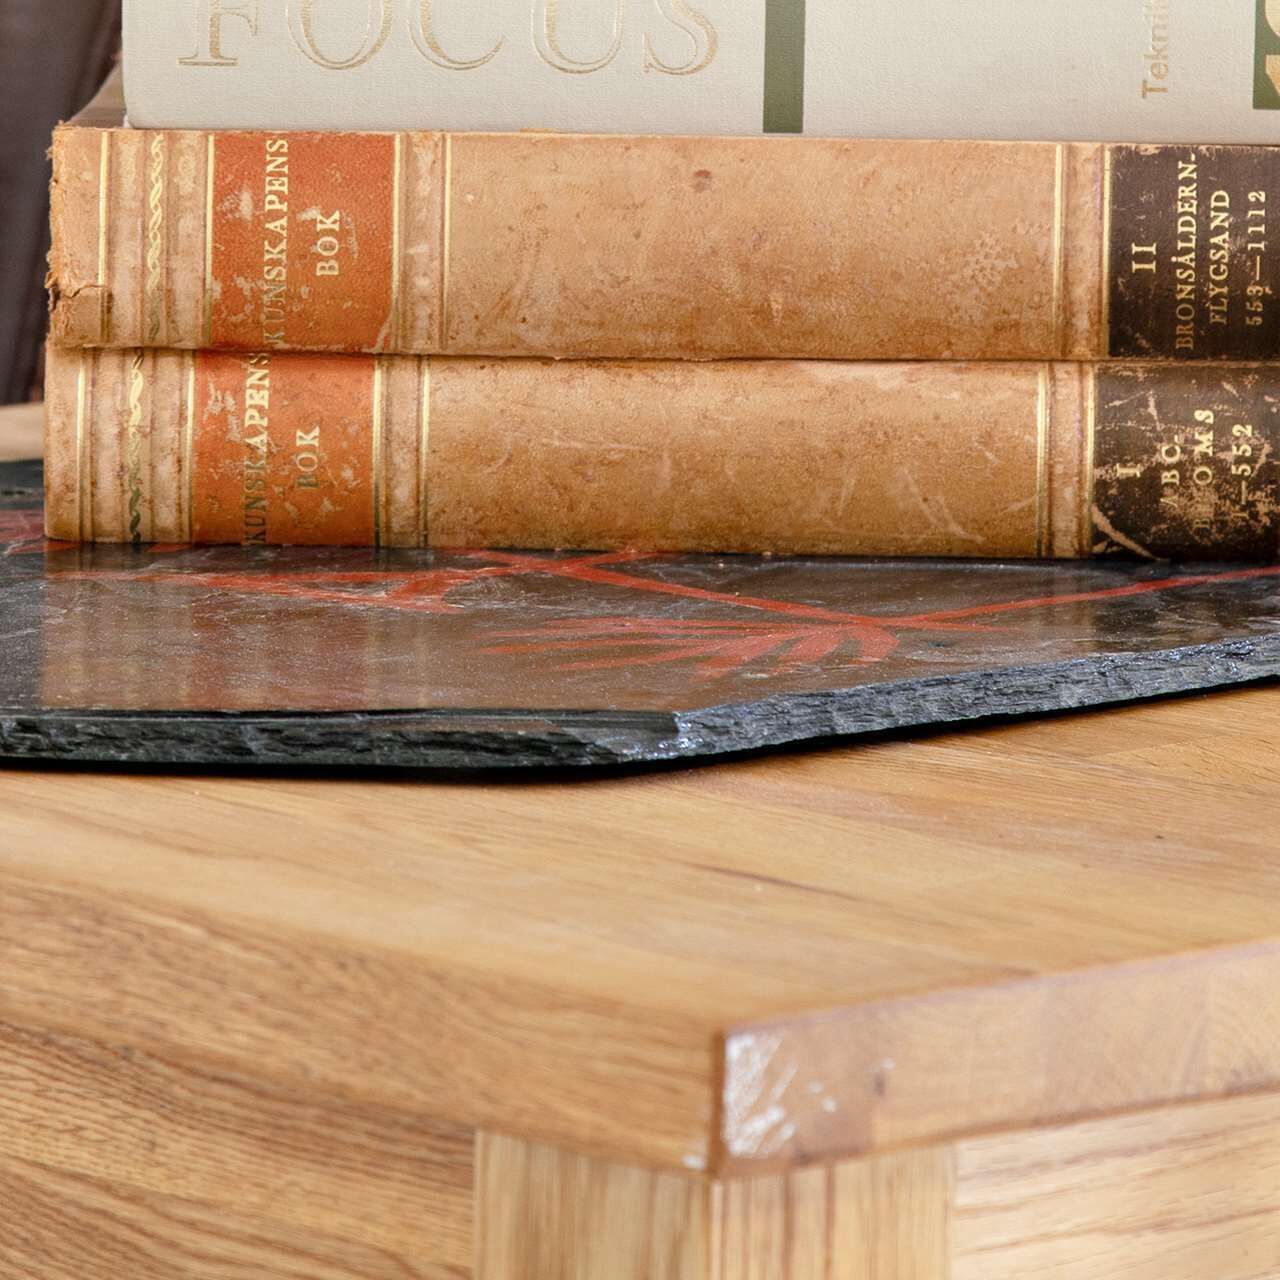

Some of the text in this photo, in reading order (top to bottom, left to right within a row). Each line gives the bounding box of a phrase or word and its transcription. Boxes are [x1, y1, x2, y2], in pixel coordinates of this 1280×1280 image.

[263, 138, 290, 346] KUNSKAPENS
[316, 209, 341, 277] BOK
[1131, 242, 1156, 273] II
[1171, 153, 1198, 350] BRONSÅLDERN-
[1209, 190, 1230, 325] FLYGSAND
[295, 425, 321, 490] BOK
[1193, 409, 1214, 529] BOMS
